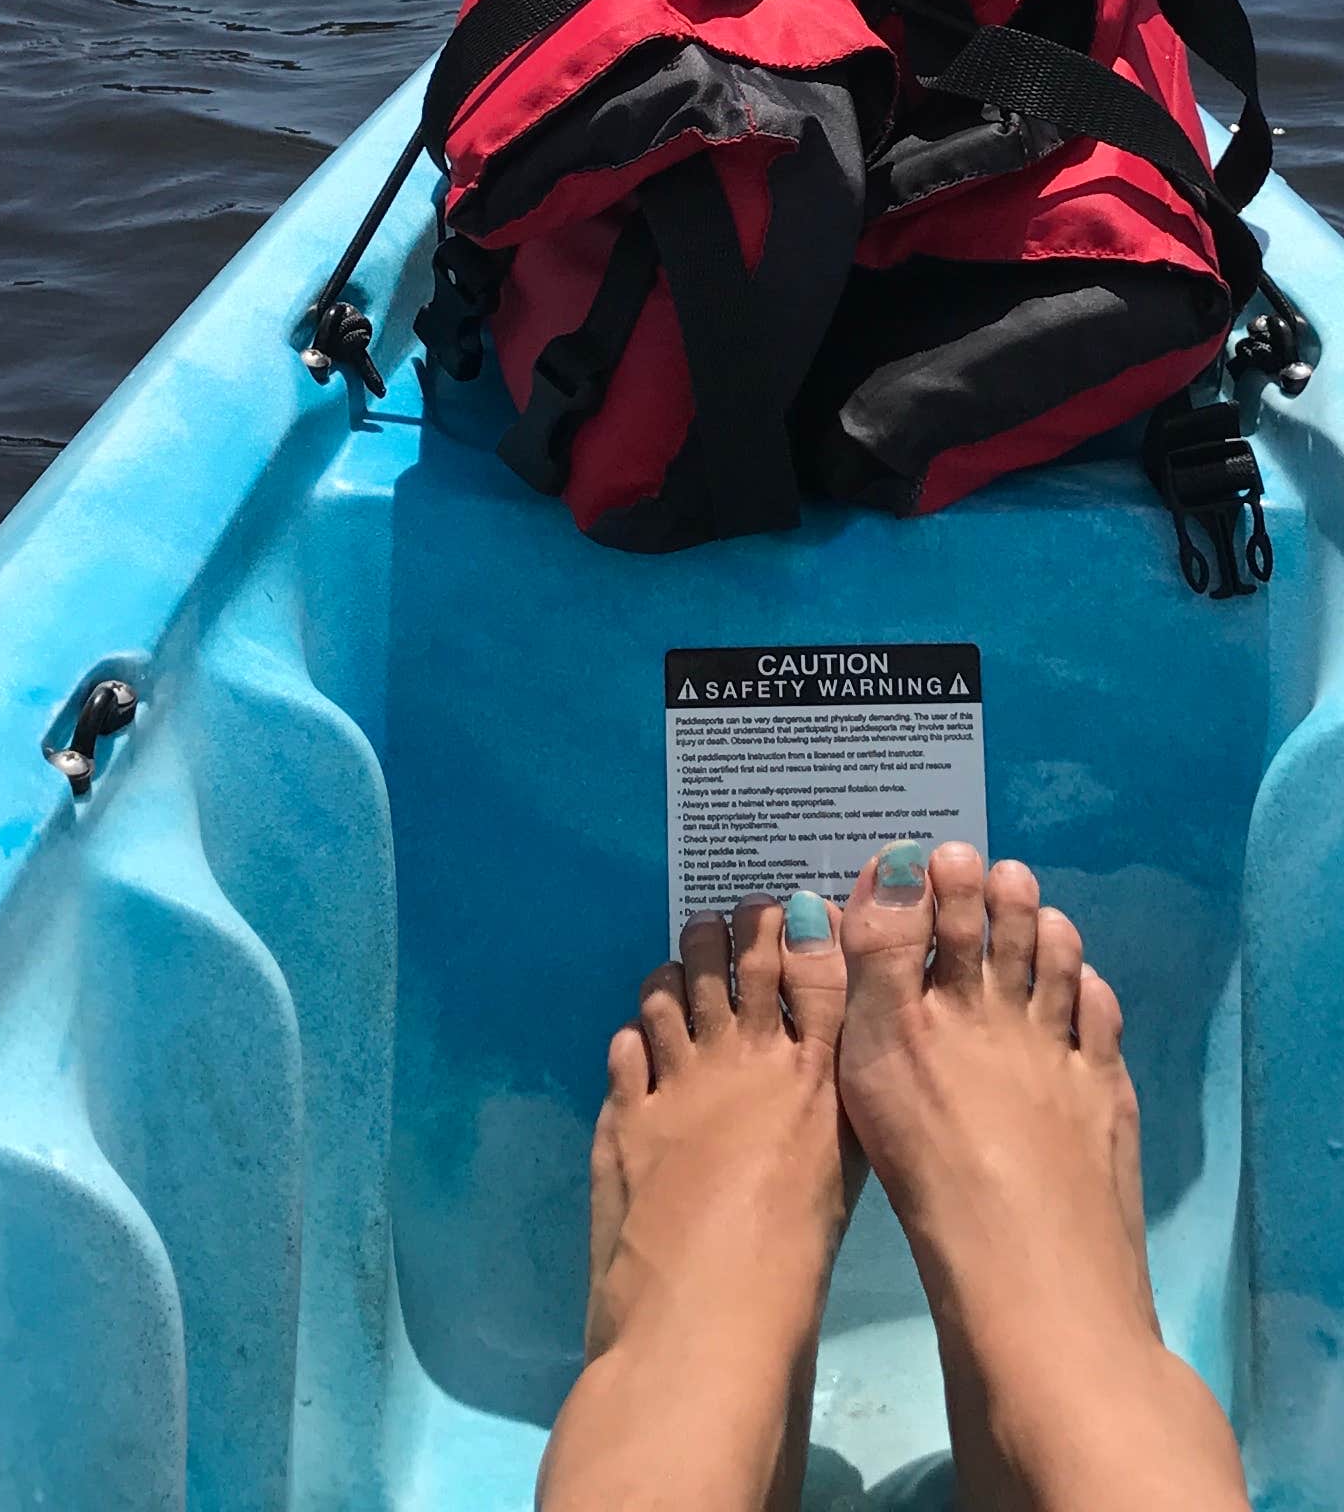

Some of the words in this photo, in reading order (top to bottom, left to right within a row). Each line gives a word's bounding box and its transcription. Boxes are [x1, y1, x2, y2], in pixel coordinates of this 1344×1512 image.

[758, 654, 888, 675] CAUTION
[706, 680, 805, 700] SAFETY
[818, 678, 942, 697] WARNING
[676, 716, 724, 726] Paddlesports
[754, 717, 770, 725] very
[772, 715, 812, 725] dangerous
[831, 714, 866, 724] physically
[869, 713, 911, 723] demanding.
[676, 727, 704, 736] product
[733, 726, 774, 734] understand
[793, 725, 838, 735] participating
[850, 724, 897, 734] paddlesports
[899, 725, 915, 733] may
[676, 737, 696, 747] injury
[777, 736, 809, 746] following
[810, 735, 832, 745] safety
[834, 735, 869, 743] standards
[908, 734, 928, 744] using
[944, 733, 973, 743] product.
[697, 753, 746, 763] paddlesports
[748, 752, 786, 760] instruction
[814, 751, 845, 759] licensed
[888, 750, 924, 758] instructor.
[813, 763, 841, 773] training
[859, 764, 878, 772] carry
[682, 775, 723, 785] equipment.
[682, 788, 709, 797] Always
[814, 785, 846, 795] personal
[682, 800, 709, 810] Always
[791, 798, 836, 808] appropriate.
[707, 812, 756, 822] appropriately
[709, 836, 726, 844] your
[728, 834, 768, 844] equipment
[770, 834, 787, 843] prior
[847, 832, 867, 842] signs
[708, 847, 734, 857] paddle
[711, 860, 737, 870] paddle
[768, 858, 809, 866] conditions.
[731, 872, 774, 882] appropriate
[734, 882, 767, 890] weather
[767, 881, 800, 891] changes.
